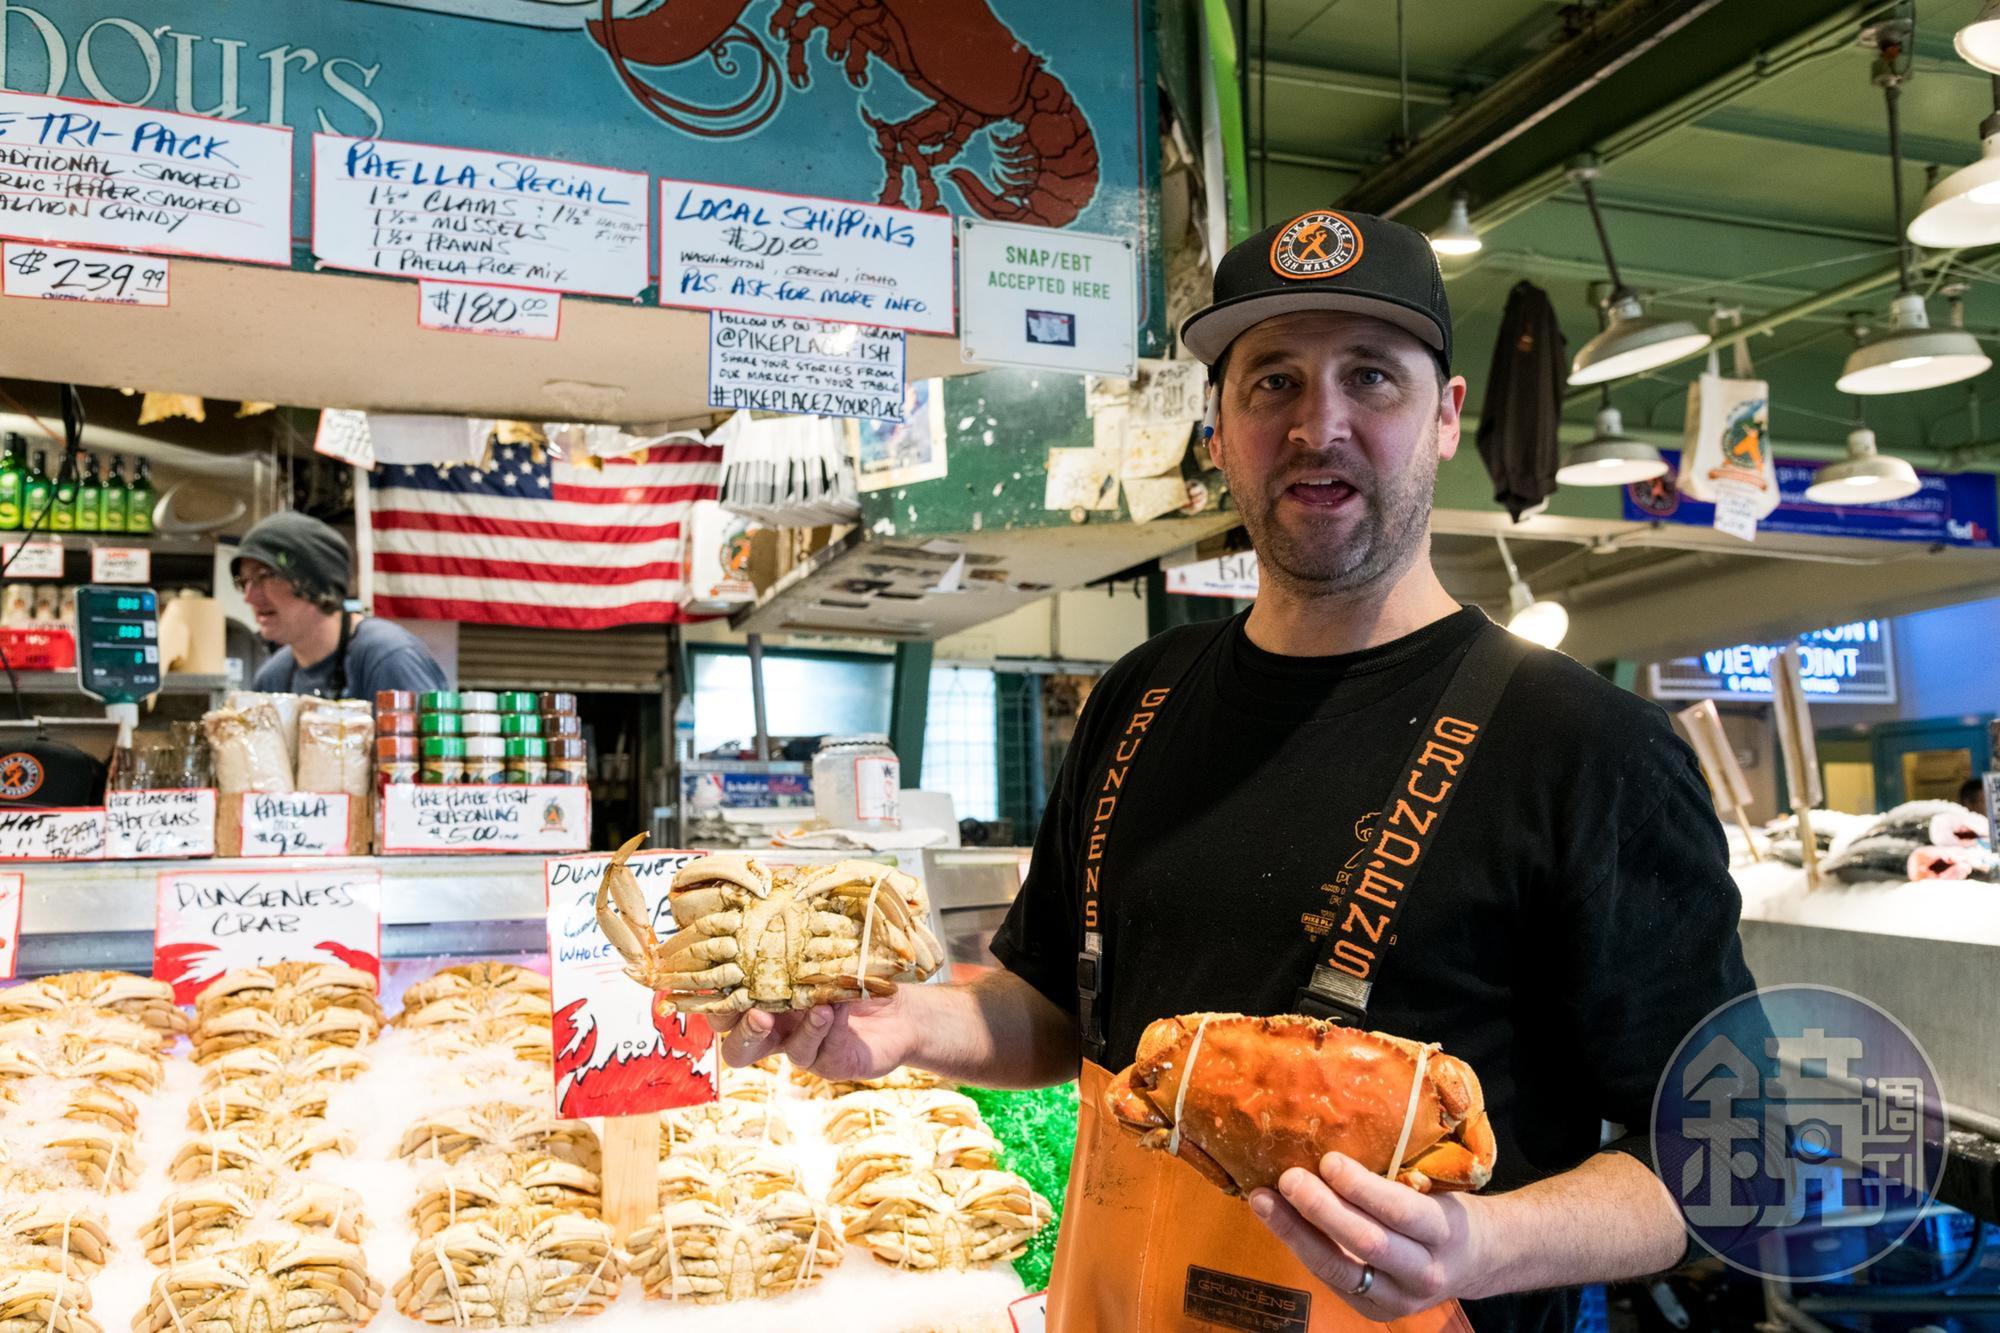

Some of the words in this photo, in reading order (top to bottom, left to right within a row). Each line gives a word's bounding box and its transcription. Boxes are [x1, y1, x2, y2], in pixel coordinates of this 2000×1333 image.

[131, 122, 239, 168] PACK
[133, 163, 240, 190] SMOKED
[346, 141, 487, 189] PAELLA
[490, 161, 630, 206] SPECIAL
[65, 174, 141, 203] PEPPER
[143, 190, 241, 215] SMOKED
[423, 190, 517, 216] CLAMS
[100, 202, 189, 233] CANDY
[432, 216, 547, 241] MUSSELS
[675, 189, 771, 226] LOCAL
[780, 205, 915, 248] SHIPPING
[1317, 216, 1352, 240] PLACE
[427, 232, 511, 255] PRAWNS
[400, 249, 468, 275] PAELLA
[1005, 246, 1092, 273] SNAP/EBT
[1280, 253, 1299, 270] FISH
[1303, 250, 1348, 271] MARKET
[731, 276, 771, 299] ASK
[821, 291, 873, 309] MORE
[988, 271, 1065, 296] ACCEPTED
[1072, 281, 1111, 299] HERE
[793, 319, 810, 332] ON
[747, 371, 799, 384] MARKET
[761, 357, 790, 371] YOUR
[796, 361, 852, 376] STORIES
[857, 366, 896, 380] FROM
[1704, 645, 1859, 678] VIEWOINT
[254, 796, 332, 821] PAELLA
[418, 805, 520, 827] SEASONING
[175, 880, 355, 911] DUNGENESS
[212, 912, 301, 936] CRAB
[560, 944, 612, 962] WHOLE
